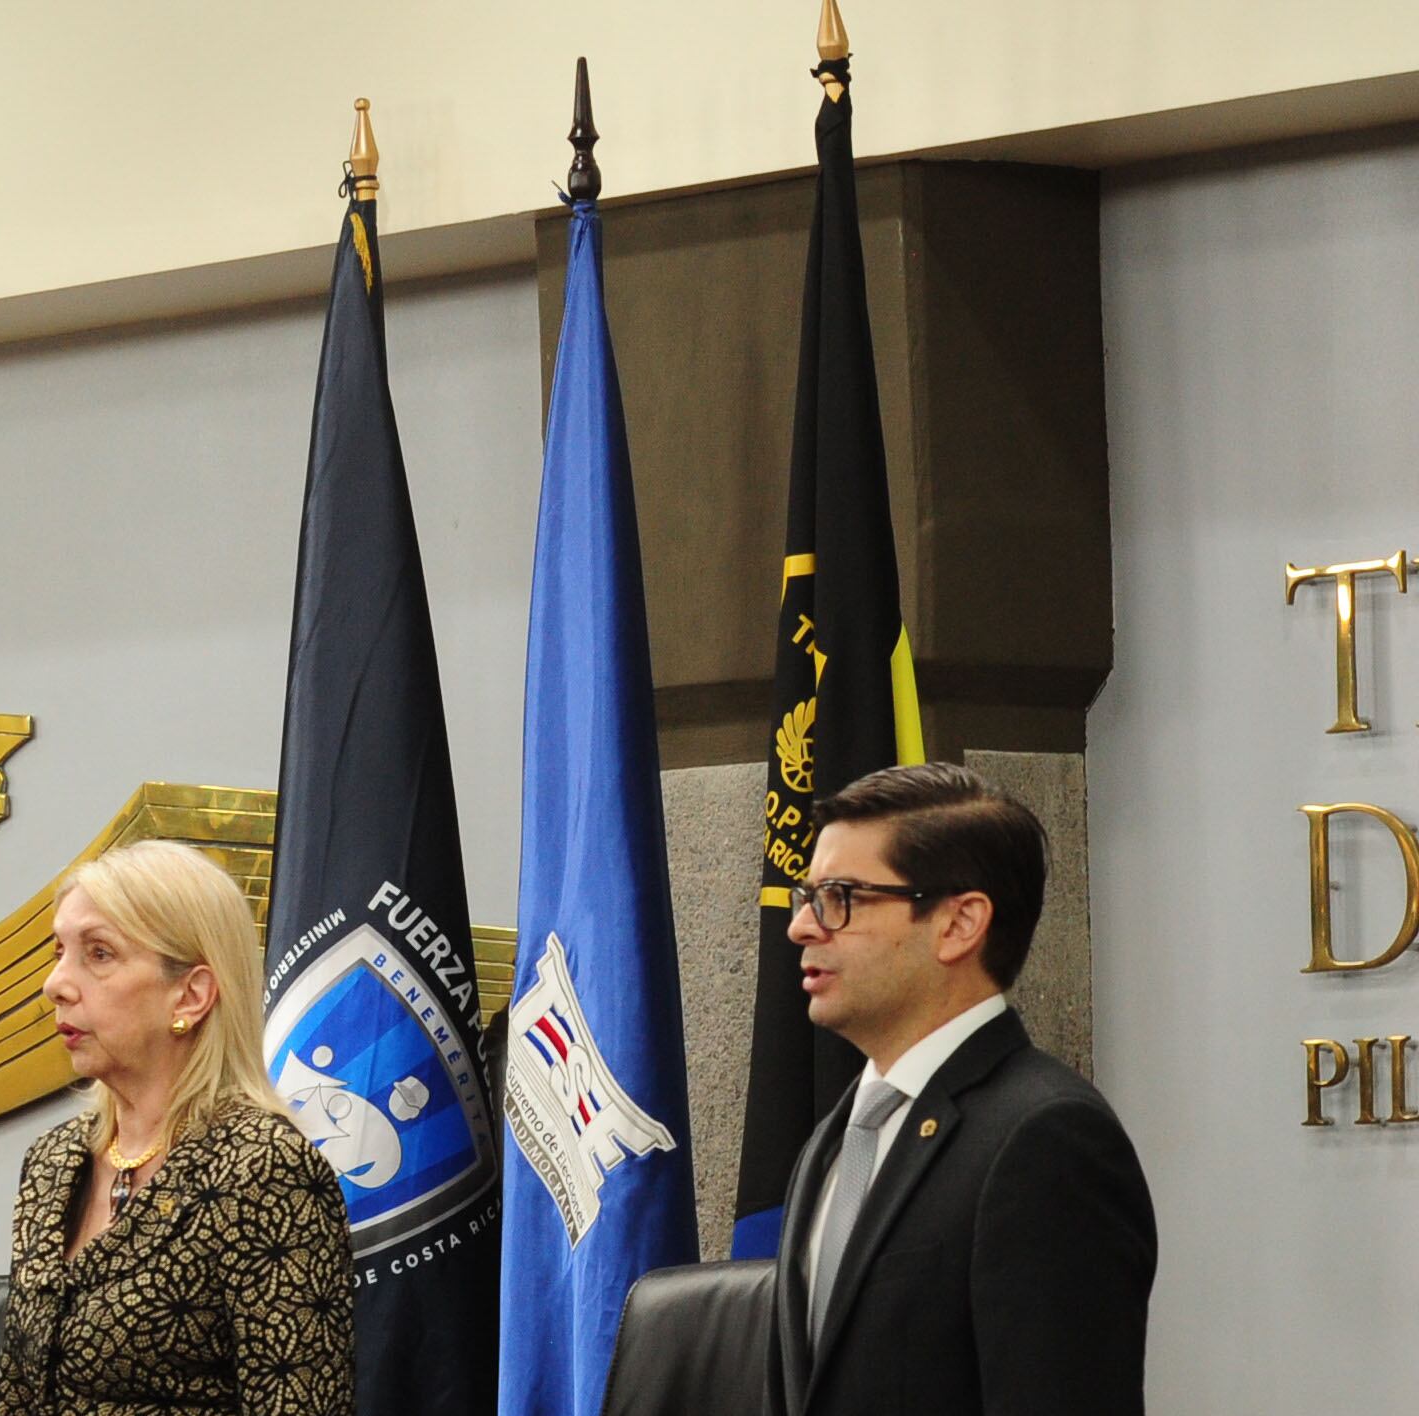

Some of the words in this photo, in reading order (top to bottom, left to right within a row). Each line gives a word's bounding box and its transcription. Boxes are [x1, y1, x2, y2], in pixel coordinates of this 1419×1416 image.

[269, 908, 346, 990] MINISTERIO
[367, 880, 473, 1013] FUERZA
[372, 952, 487, 1148] BENEMÉRITA
[506, 1065, 544, 1133] Supremo
[542, 1133, 559, 1153] de
[390, 1233, 462, 1275] COSTA
